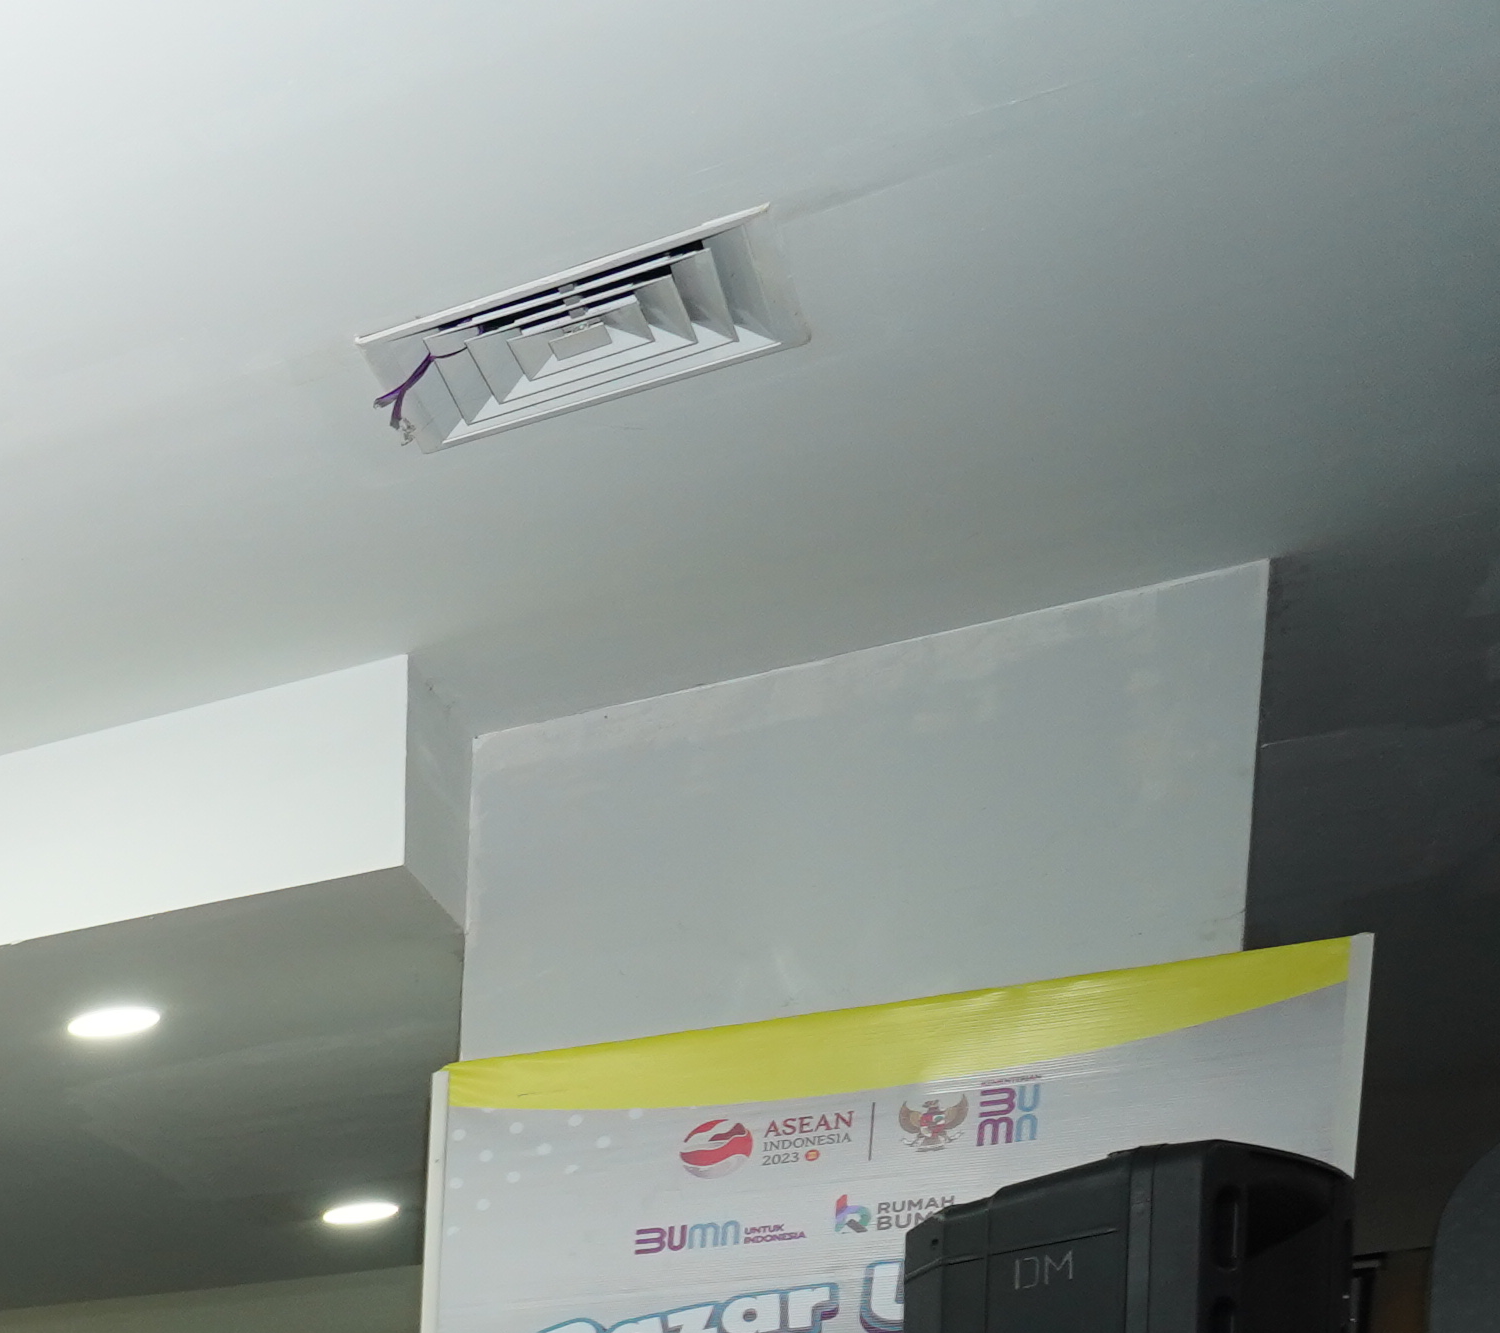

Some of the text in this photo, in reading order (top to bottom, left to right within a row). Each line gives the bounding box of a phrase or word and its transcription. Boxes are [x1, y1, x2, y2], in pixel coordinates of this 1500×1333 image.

[764, 1110, 855, 1138] ASEAN
[762, 1132, 853, 1152] INDONESIA
[761, 1151, 800, 1166] 2023
[877, 1195, 955, 1215] RUMAH
[744, 1223, 784, 1235] UNTUK
[876, 1209, 936, 1231] BUM
[743, 1230, 807, 1245] INDONESIA
